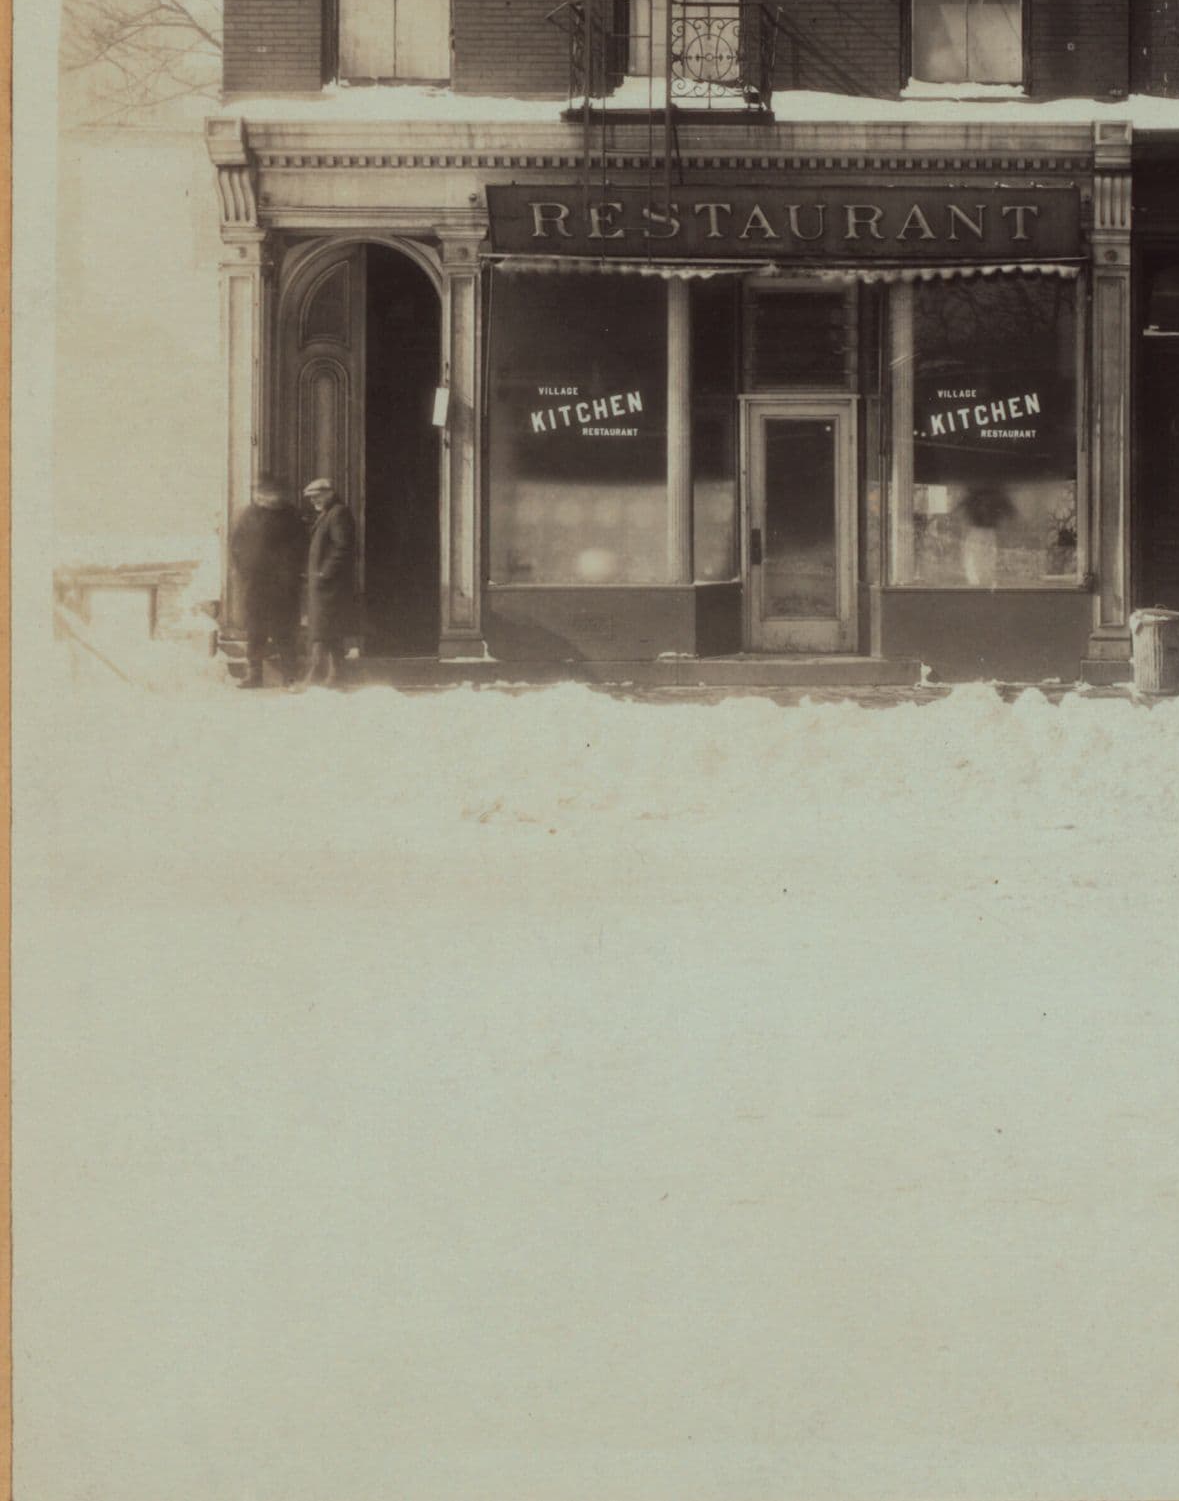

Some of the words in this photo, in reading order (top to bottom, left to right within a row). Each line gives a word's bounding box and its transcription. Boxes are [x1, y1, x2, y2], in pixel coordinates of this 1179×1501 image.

[528, 202, 1039, 240] RESTAURANT
[538, 387, 579, 396] VILLAGE
[937, 390, 977, 398] VILLAGE
[530, 391, 643, 433] KITCHEN
[931, 393, 1040, 435] KITCHEN
[582, 428, 638, 436] RESTAURANT
[980, 430, 1037, 438] RESTAURANT
